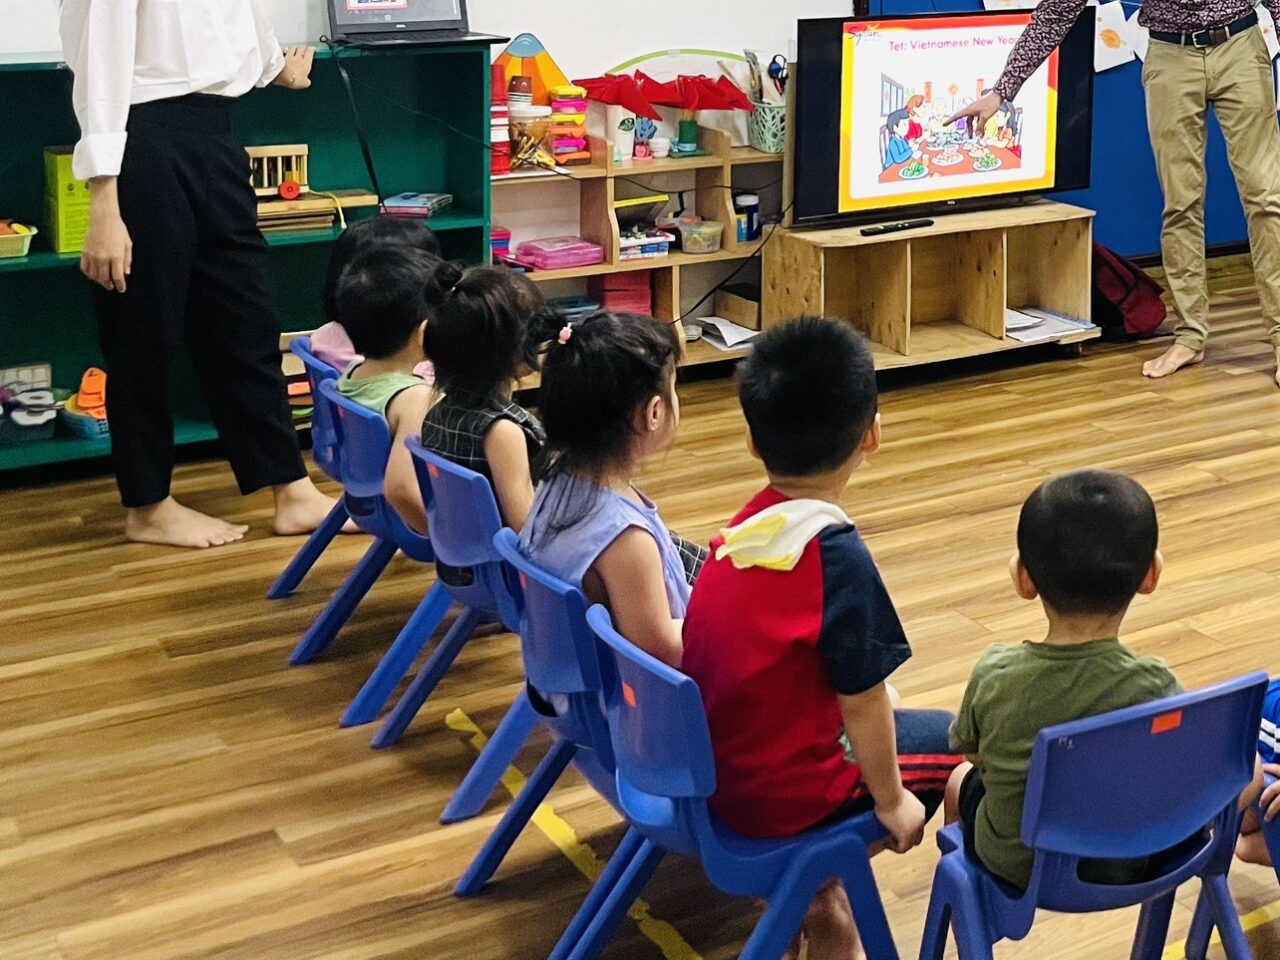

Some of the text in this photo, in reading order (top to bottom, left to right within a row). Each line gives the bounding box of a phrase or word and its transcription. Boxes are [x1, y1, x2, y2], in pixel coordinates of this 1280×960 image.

[889, 41, 907, 51] Tet:
[910, 40, 969, 49] Vietnamese
[972, 36, 994, 47] New
